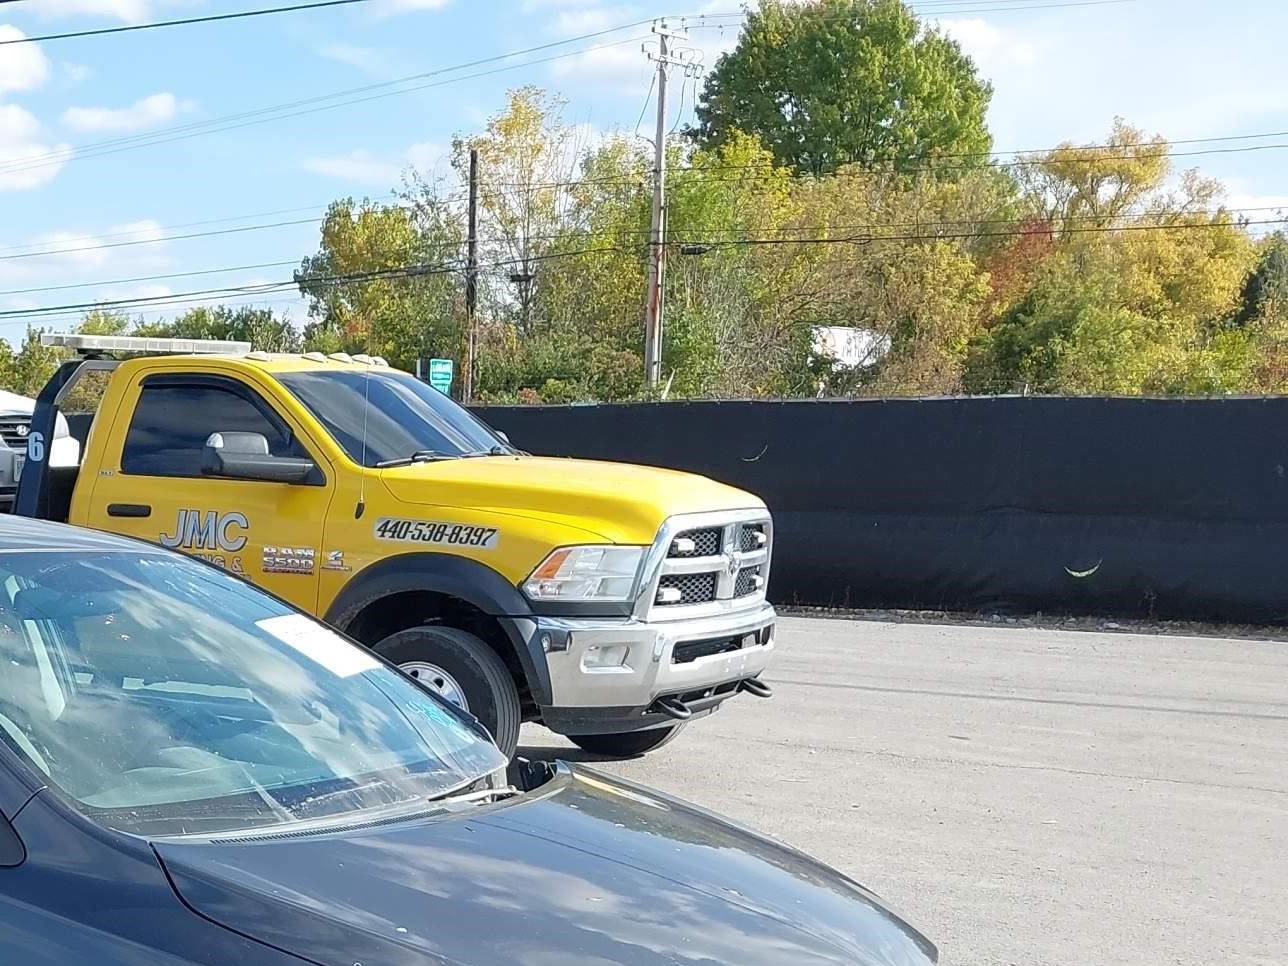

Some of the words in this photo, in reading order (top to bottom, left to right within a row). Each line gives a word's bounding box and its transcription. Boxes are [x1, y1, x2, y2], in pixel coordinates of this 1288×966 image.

[28, 431, 44, 462] 6
[159, 508, 249, 552] JMC
[376, 519, 498, 547] 440-538-8397
[263, 546, 316, 558] RAM
